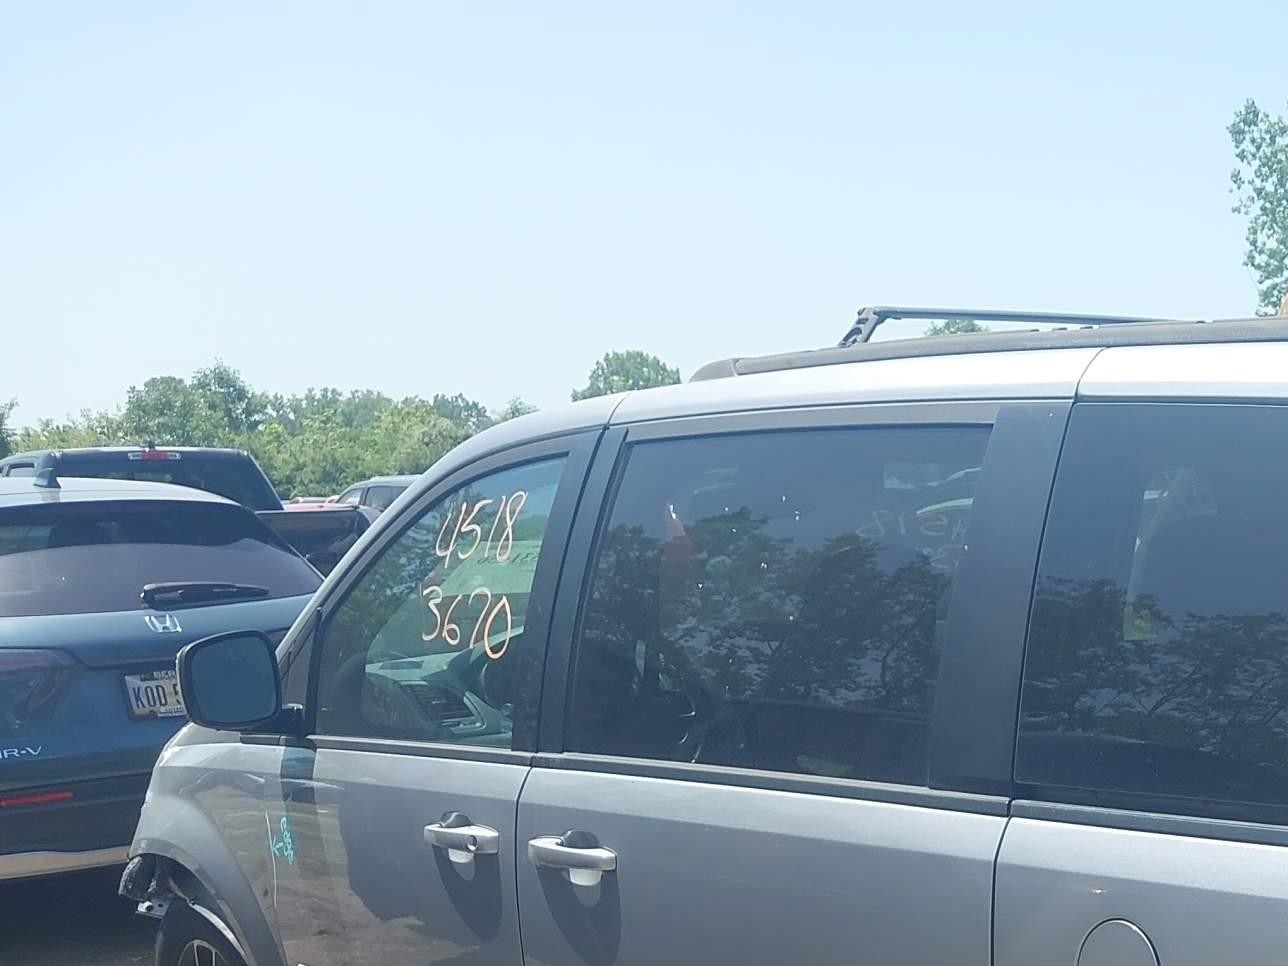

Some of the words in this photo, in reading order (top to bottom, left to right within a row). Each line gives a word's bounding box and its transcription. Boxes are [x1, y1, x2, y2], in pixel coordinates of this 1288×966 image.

[435, 490, 529, 569] 4518
[420, 585, 512, 660] 3670
[0, 745, 42, 759] R-V
